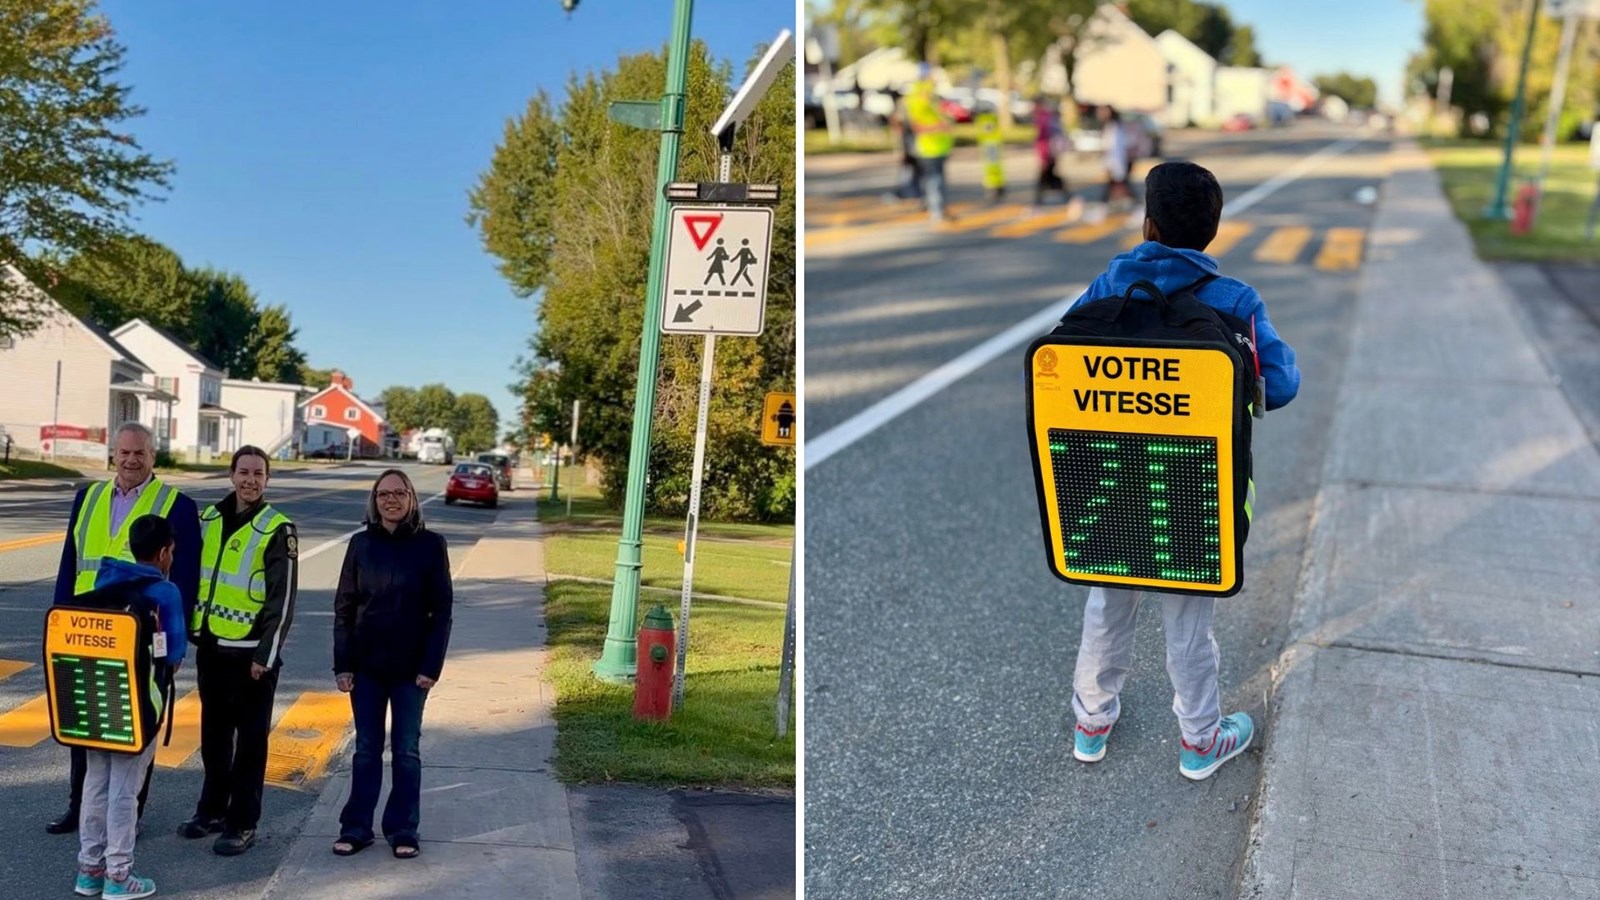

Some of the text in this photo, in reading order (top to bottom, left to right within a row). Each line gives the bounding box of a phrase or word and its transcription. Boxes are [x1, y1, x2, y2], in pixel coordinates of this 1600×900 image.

[1083, 355, 1180, 381] VOTRE
[1073, 389, 1190, 416] VITESSE
[70, 616, 113, 631] VOTRE
[64, 633, 117, 649] VITESSE
